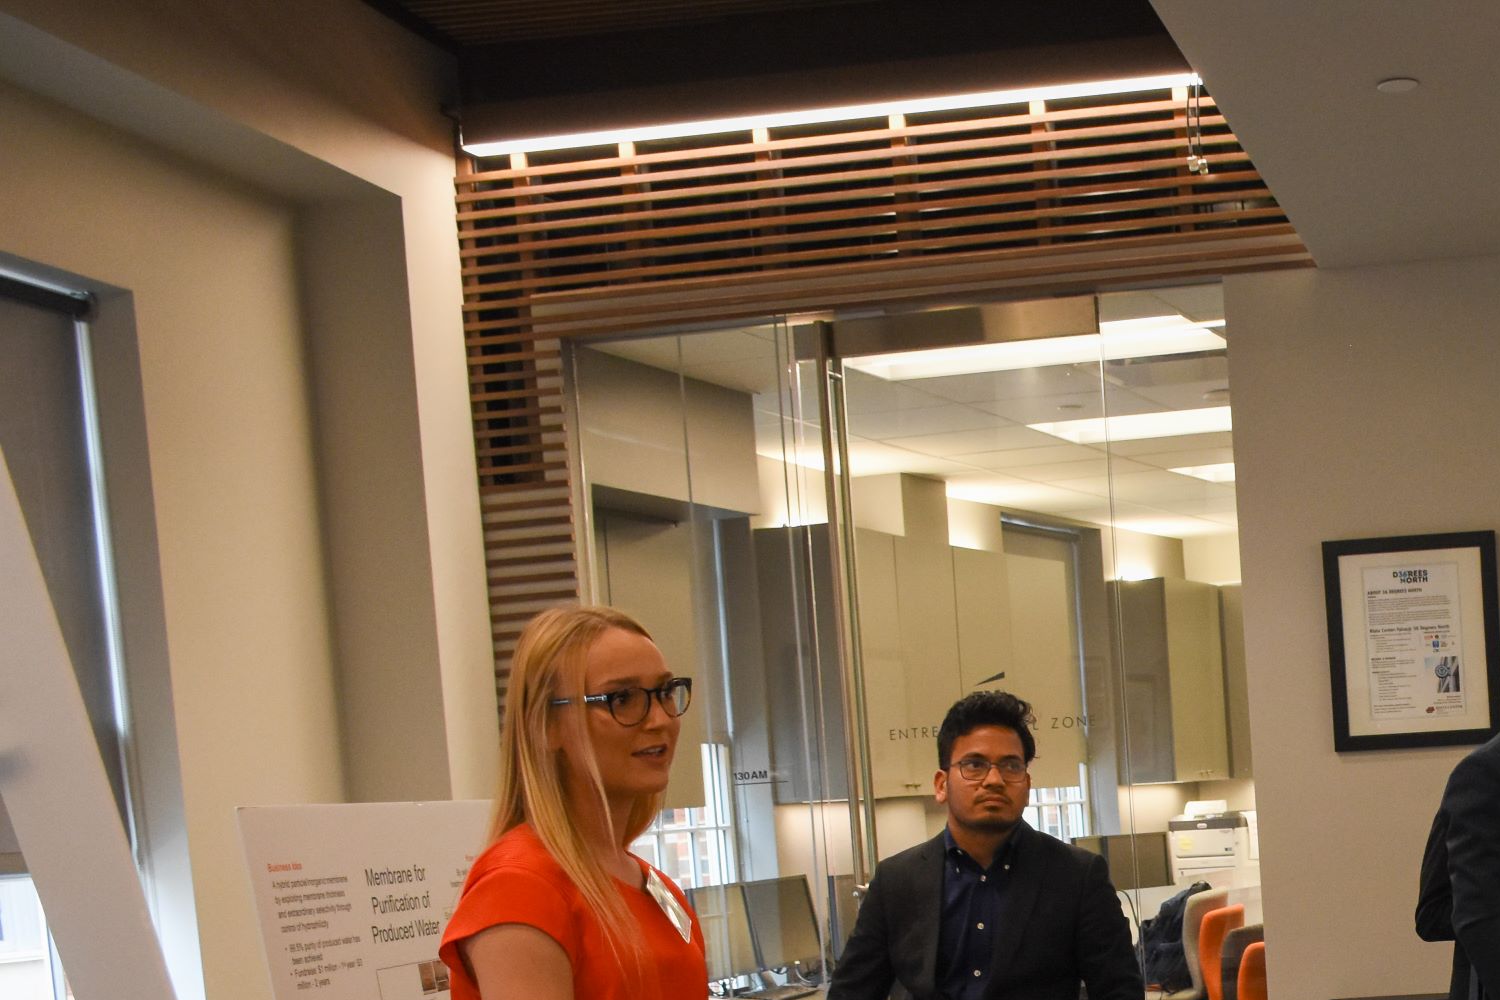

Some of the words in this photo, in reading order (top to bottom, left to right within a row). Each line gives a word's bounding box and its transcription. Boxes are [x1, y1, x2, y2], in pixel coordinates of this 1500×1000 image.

[365, 868, 412, 887] Membrane
[414, 864, 425, 882] for
[371, 894, 421, 915] Purification
[422, 891, 430, 909] of
[371, 921, 415, 944] Produced
[415, 920, 440, 936] Water
